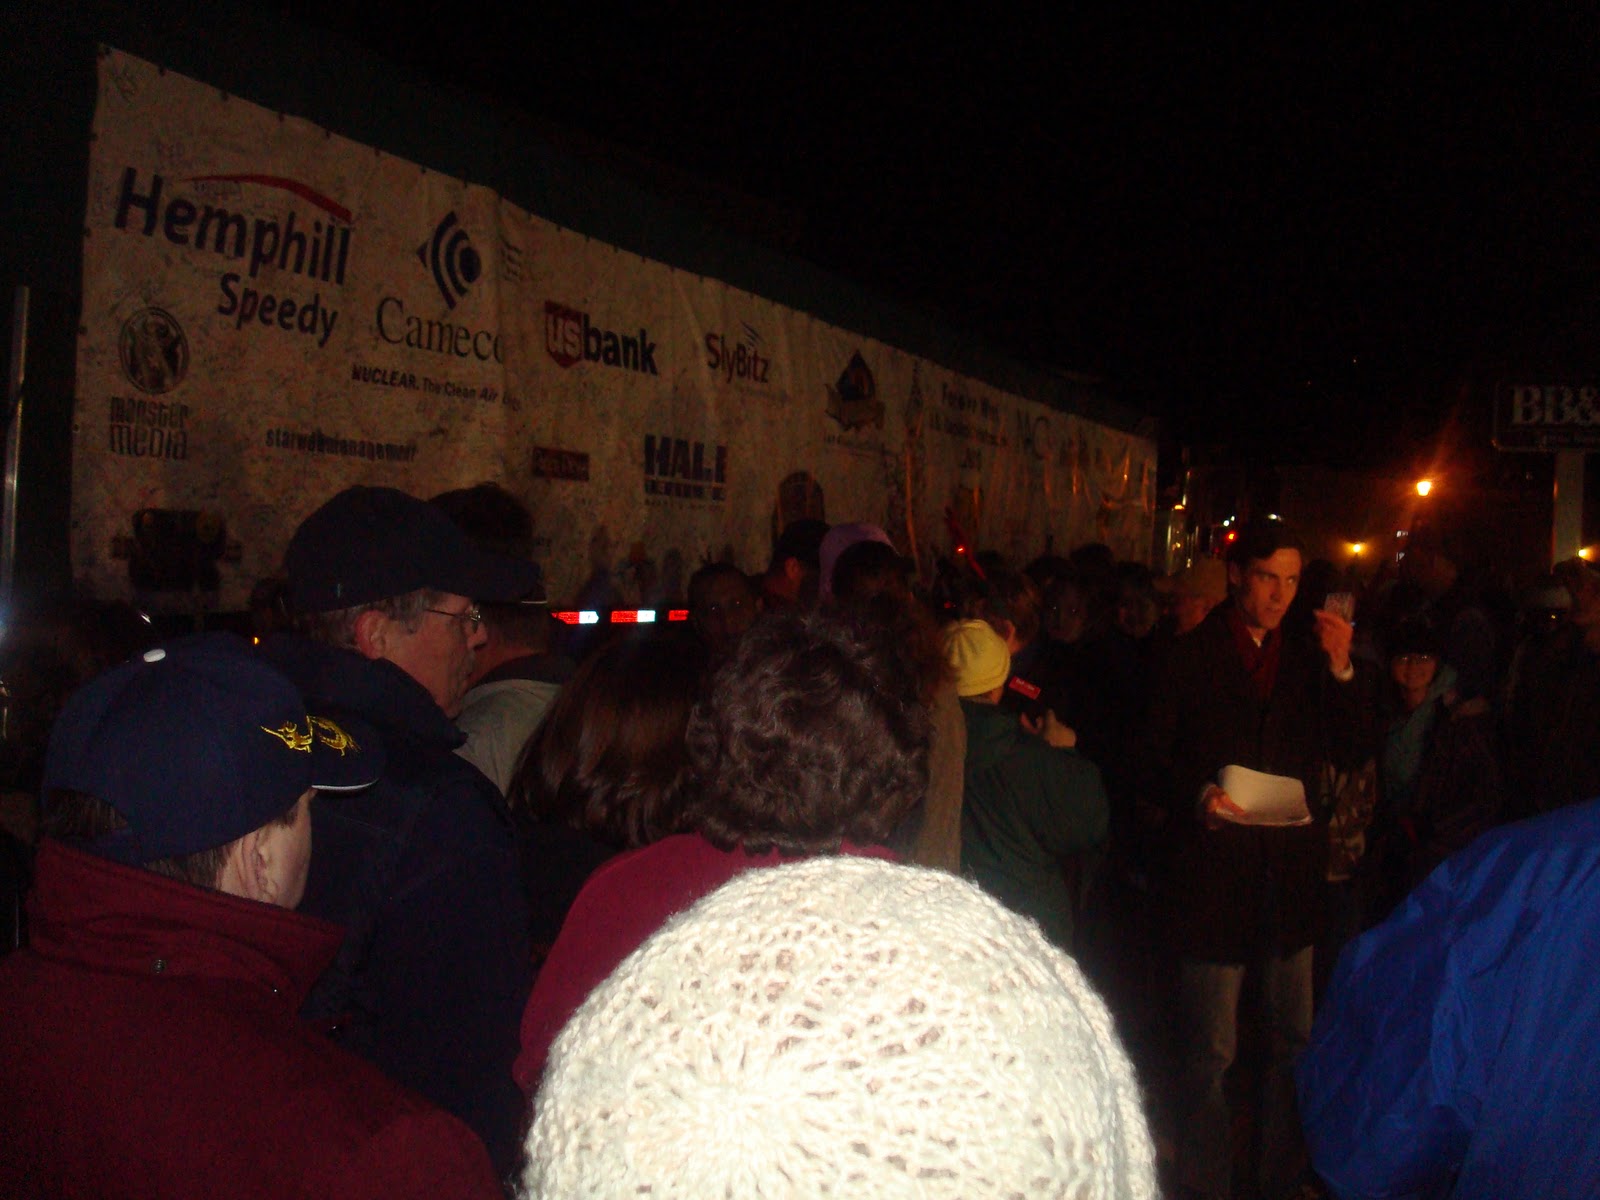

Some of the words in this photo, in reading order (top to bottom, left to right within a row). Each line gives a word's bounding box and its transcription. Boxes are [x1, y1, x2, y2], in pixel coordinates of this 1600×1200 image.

[114, 166, 352, 284] Hemphill
[217, 272, 338, 346] Speedy
[583, 312, 658, 376] bank
[705, 332, 769, 384] SlyBitz
